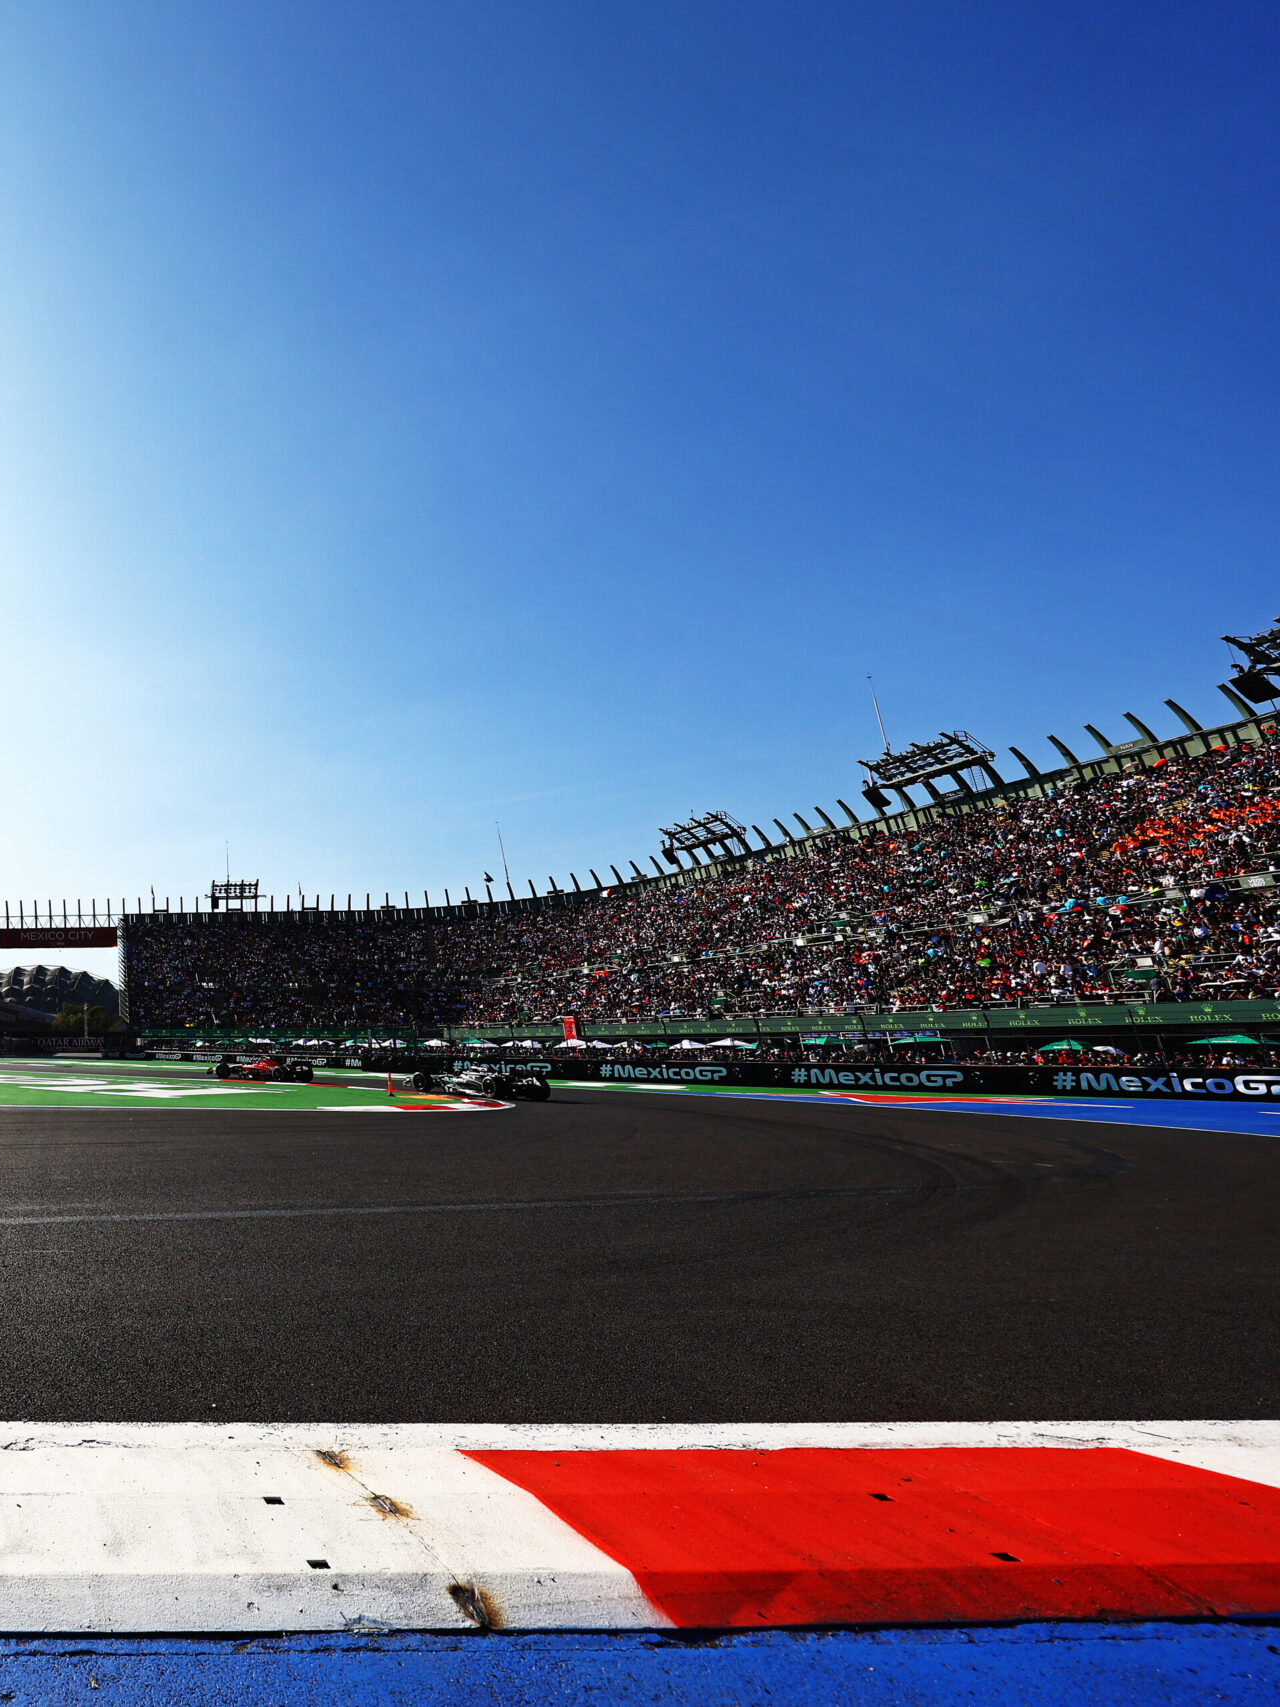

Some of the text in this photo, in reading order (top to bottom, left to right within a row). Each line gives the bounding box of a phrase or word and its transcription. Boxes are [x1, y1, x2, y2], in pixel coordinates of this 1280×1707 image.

[20, 931, 94, 941] MEXICO CITY
[1190, 1014, 1233, 1022] ROLEX
[37, 1038, 69, 1047] QATAR
[192, 1053, 223, 1062] #MexicoGP
[599, 1064, 728, 1081] #MexicoGP
[791, 1067, 964, 1088] #MexicoGP
